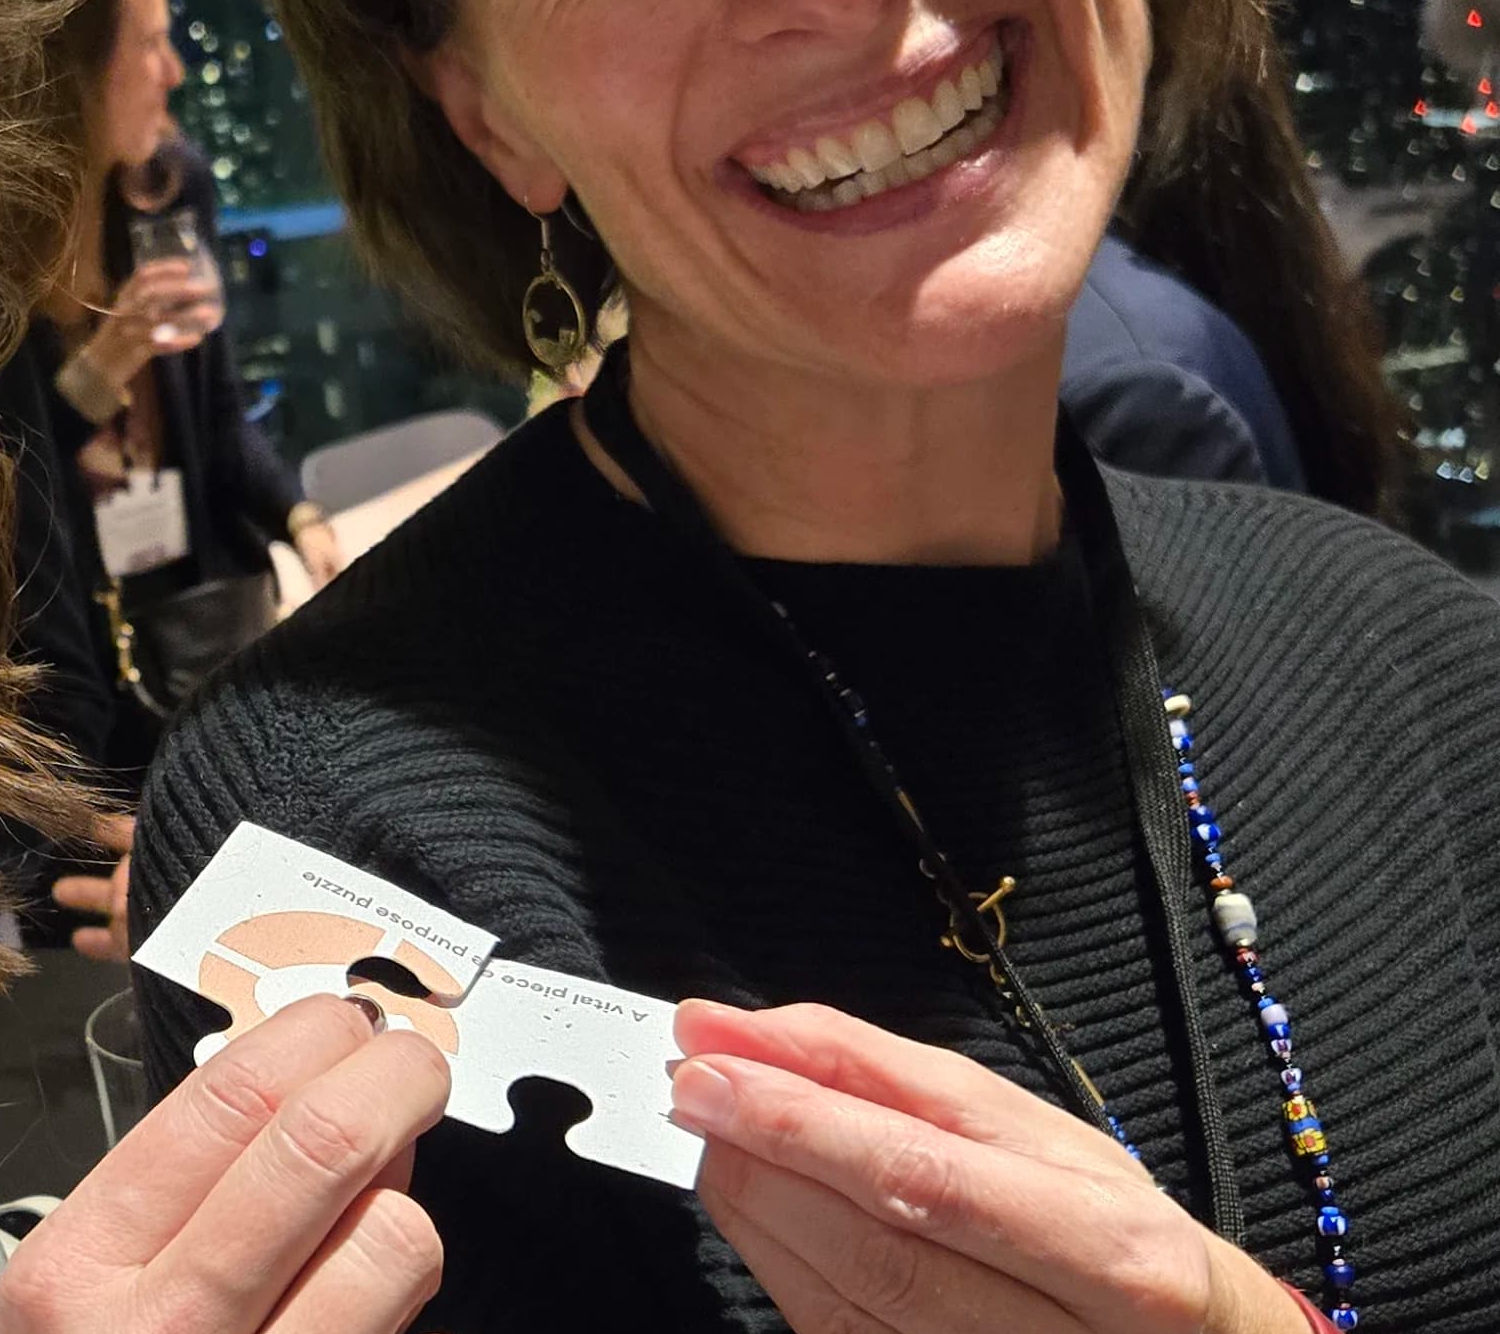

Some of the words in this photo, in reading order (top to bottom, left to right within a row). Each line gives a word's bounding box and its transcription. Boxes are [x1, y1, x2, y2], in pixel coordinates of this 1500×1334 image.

[302, 870, 374, 909] puzzle
[376, 904, 469, 957] purpose
[501, 974, 569, 999] piece
[571, 993, 624, 1015] vital
[631, 1008, 649, 1023] A
